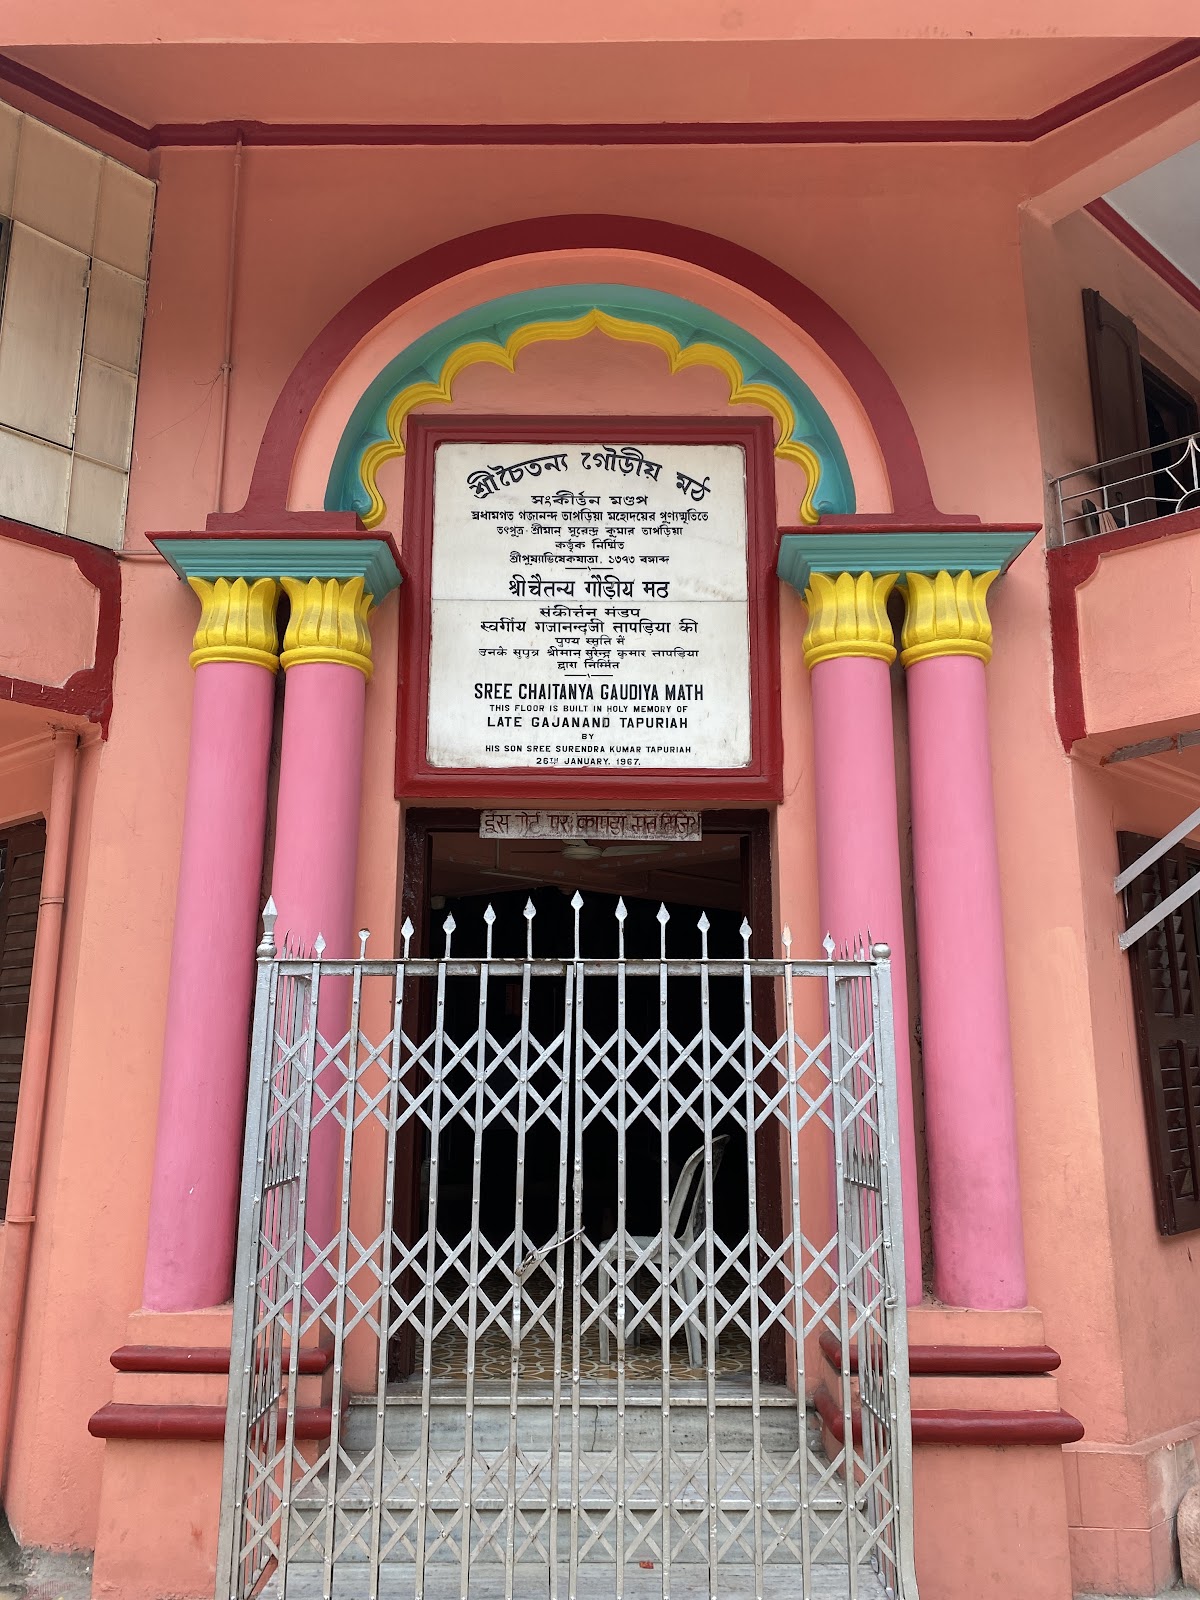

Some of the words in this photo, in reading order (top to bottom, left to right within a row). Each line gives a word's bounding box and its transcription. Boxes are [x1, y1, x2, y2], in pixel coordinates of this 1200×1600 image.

[467, 454, 568, 499] শ্রীচৈতন্য
[581, 445, 662, 482] গৌড়ীয়
[676, 472, 711, 501] মঠ
[609, 495, 648, 506] মণ্ডপ
[519, 510, 557, 520] গজানন্দ
[562, 508, 603, 523] তাপড়িয়া
[607, 512, 656, 522] মহোদয়ের
[605, 527, 635, 538] কুমার
[642, 524, 683, 537] তাপড়িয়া
[642, 582, 670, 598] मठ
[605, 606, 640, 617] मंडप
[481, 617, 526, 632] स्वर्गीय
[613, 618, 671, 636] तापड़िया
[679, 618, 698, 633] की
[555, 638, 580, 648] पुण्य
[616, 635, 625, 645] में
[479, 647, 507, 656] उनके
[513, 649, 539, 659] सुपुत्र
[585, 647, 611, 661] सुरेन्द्र
[617, 650, 646, 659] कुमार
[557, 662, 577, 670] द्वारा
[474, 682, 513, 700] SREE
[518, 683, 594, 700] CHAITANYA
[600, 683, 659, 701] GAUDIYA
[665, 684, 704, 701] MATH
[489, 704, 510, 712] THIS
[514, 704, 545, 712] FLOOR
[549, 704, 559, 712] IS
[563, 704, 589, 713] BUILT
[593, 705, 602, 713] IN
[606, 705, 629, 713] HOLY
[633, 705, 672, 713] MEMORY
[676, 705, 689, 713] OF
[487, 716, 523, 728] LATE
[531, 716, 610, 728] GAJANAND
[619, 717, 688, 729] TAPURIAH
[485, 744, 500, 752] HIS
[503, 744, 523, 752] SON
[526, 745, 551, 753] SREE
[555, 745, 606, 753] SURENDRA
[609, 745, 642, 753] KUMAR
[645, 746, 691, 754] TAPURIAH
